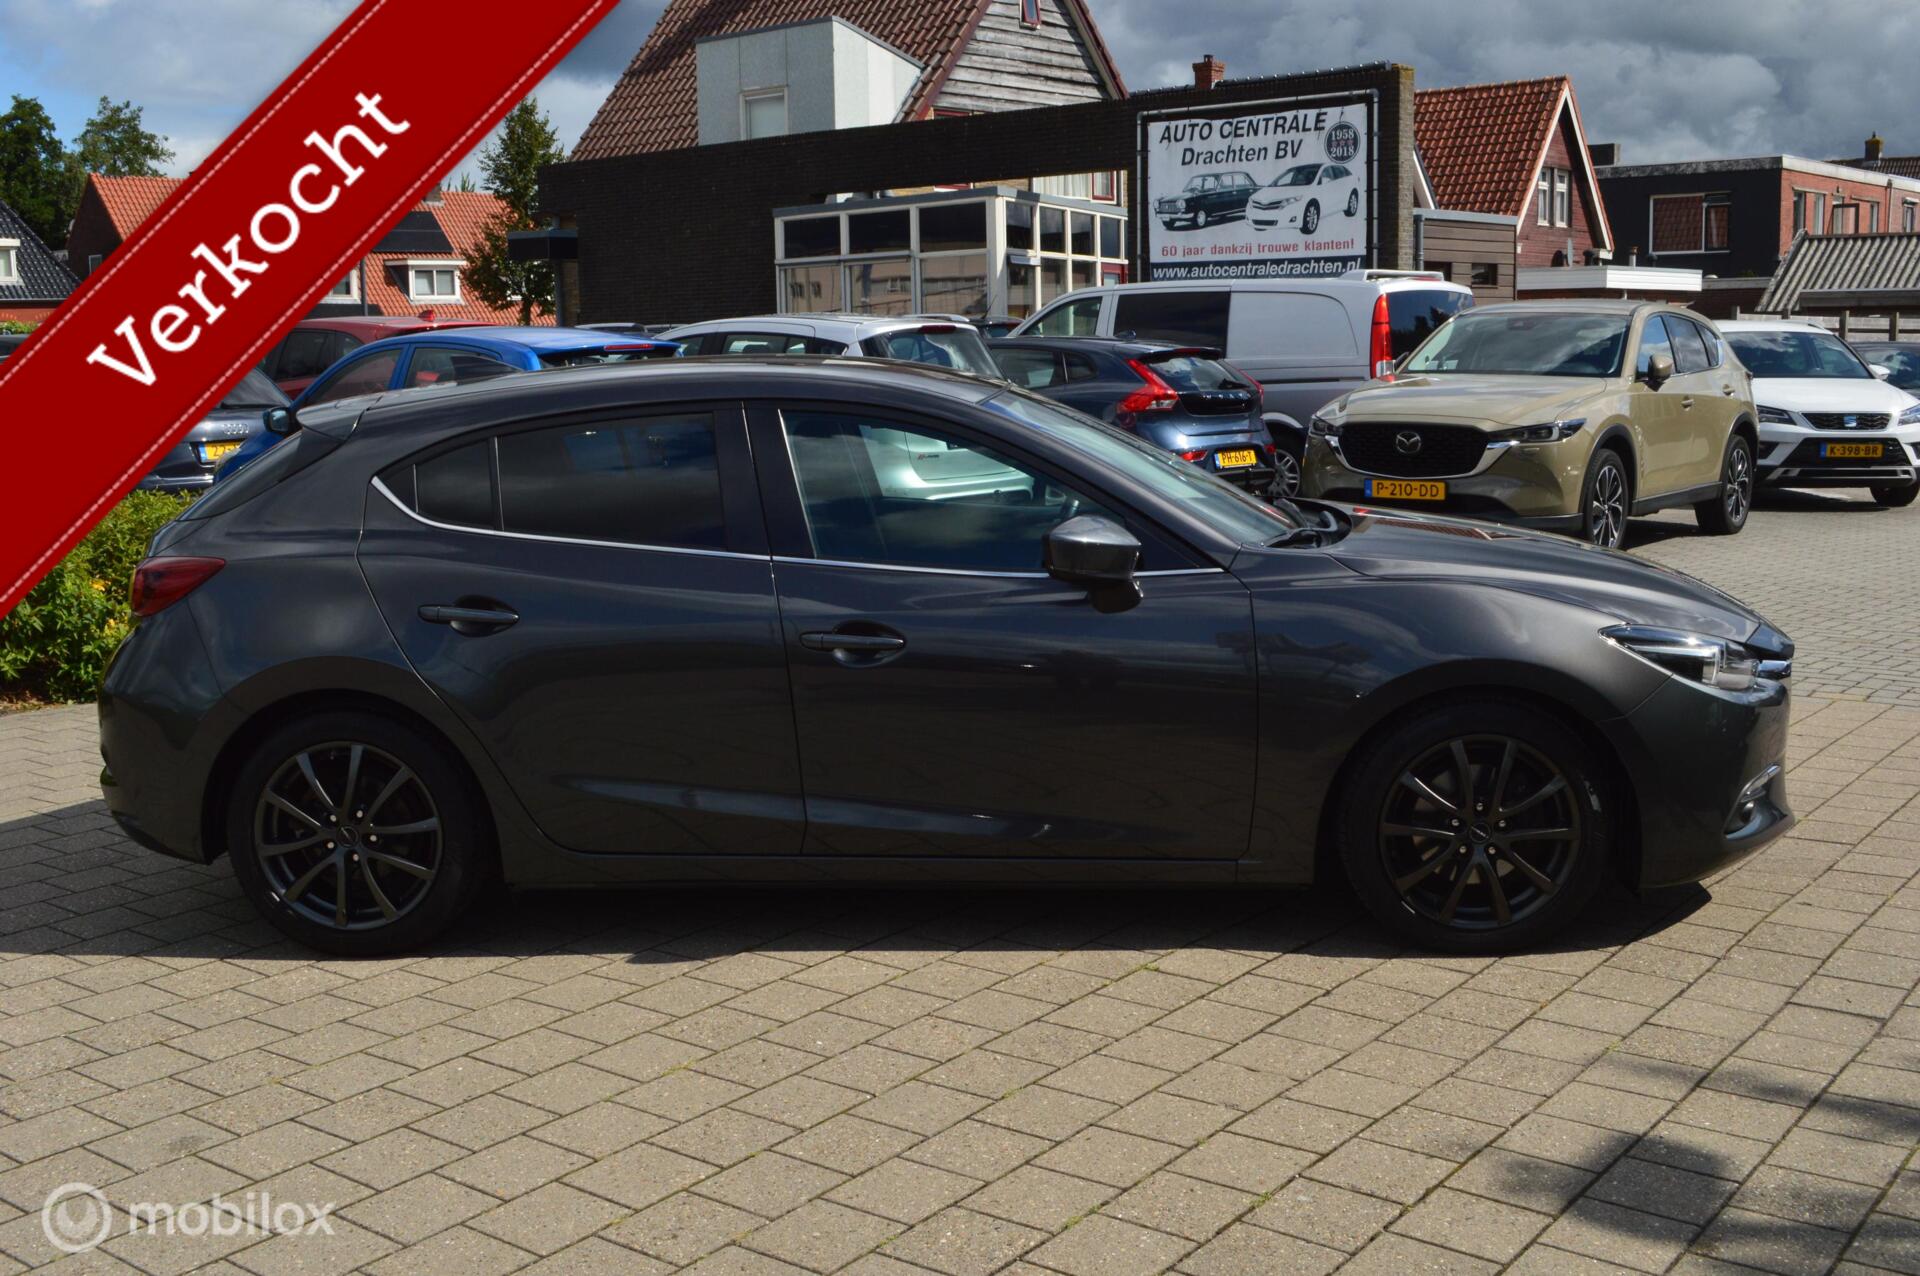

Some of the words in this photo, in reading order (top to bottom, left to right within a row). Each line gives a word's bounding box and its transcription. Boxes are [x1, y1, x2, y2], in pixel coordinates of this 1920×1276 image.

[1159, 122, 1213, 144] AUTO
[1219, 111, 1328, 139] CENTRALE
[1331, 128, 1355, 140] 1958
[1181, 145, 1268, 166] Drachten
[1274, 139, 1303, 160] BV
[1330, 145, 1355, 157] 2018
[1161, 245, 1177, 257] 60
[1182, 245, 1205, 257] jaar
[1210, 242, 1252, 256] dankzij
[1257, 242, 1299, 253] trouwe
[1304, 238, 1355, 252] klanten!
[1153, 258, 1361, 278] www.autocentraledrachten.nl
[1376, 482, 1439, 497] P-210-DD
